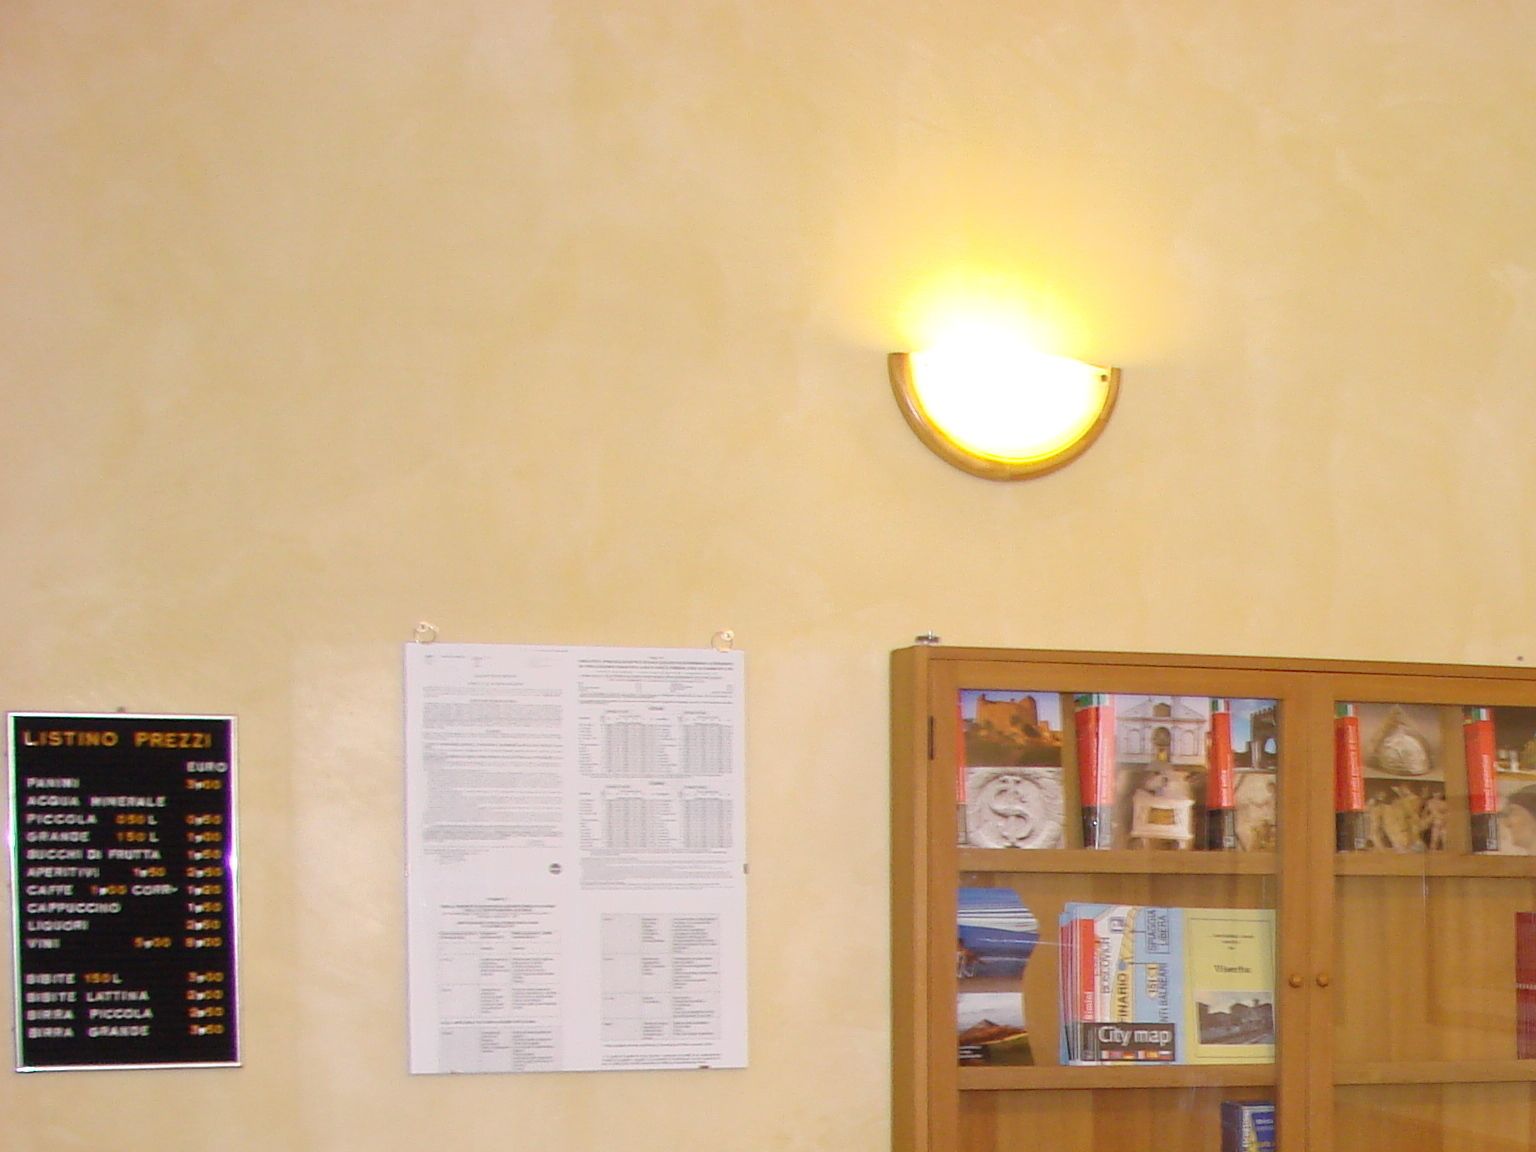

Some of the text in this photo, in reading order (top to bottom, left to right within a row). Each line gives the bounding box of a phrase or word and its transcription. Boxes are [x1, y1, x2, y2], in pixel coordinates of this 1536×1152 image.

[23, 731, 212, 748] LISTINO PREZZI
[185, 761, 228, 773] EURO
[26, 777, 80, 789] PANINI
[26, 795, 166, 808] ACQUA MINERALE
[26, 813, 98, 825] PICCOLA
[26, 831, 90, 843] GRANDE
[26, 848, 83, 860] SUCCHI
[86, 849, 102, 860] DI
[107, 849, 161, 860] FRUTTA
[26, 866, 100, 878] APERITIVI
[26, 884, 74, 896] CAFFE
[26, 902, 122, 914] CAPPUCCINO
[26, 919, 90, 931] LIQUORI
[26, 938, 61, 949] VINI
[26, 973, 76, 985] BIBITE
[26, 991, 77, 1003] BIBITE
[86, 990, 149, 1002] LATTINA
[26, 1009, 75, 1021] BIRRA
[89, 1007, 153, 1019] PICCOLA
[27, 1027, 75, 1039] BIRRA
[88, 1025, 150, 1038] GRANDE
[1098, 1025, 1172, 1047] City map
